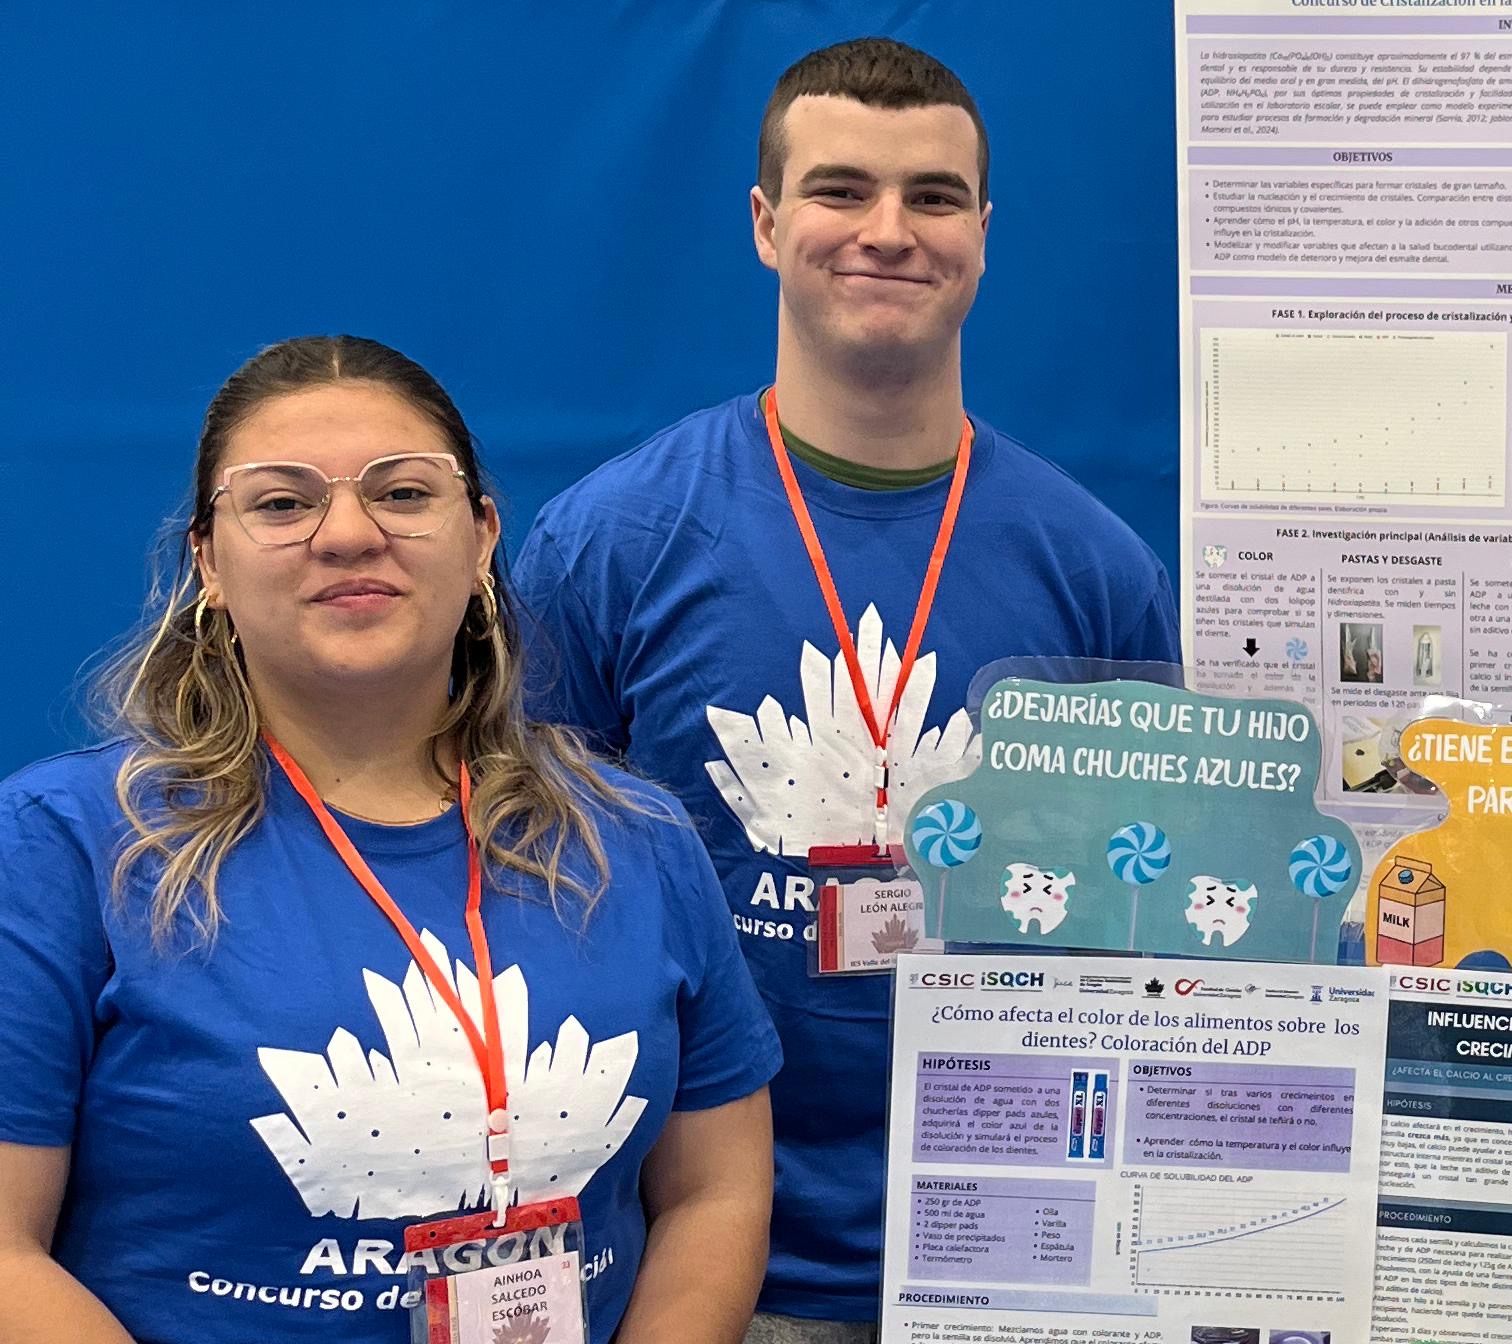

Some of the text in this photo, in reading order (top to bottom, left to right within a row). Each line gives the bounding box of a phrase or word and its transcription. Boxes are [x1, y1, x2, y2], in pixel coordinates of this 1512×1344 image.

[1332, 151, 1393, 163] OBJETIVOS
[1237, 551, 1273, 561] COLOR
[1341, 553, 1442, 566] PASTAS Y DESGASTE
[987, 691, 1313, 741] ¿DEJARÍAS QUE TU HIJO
[1407, 737, 1492, 763] ¿TIENE
[990, 740, 1301, 792] COMA CHUCHES AZULES?
[931, 1003, 1359, 1035] ¿Cómo afecta el color de los alimentos sobre los
[1021, 1030, 1271, 1056] dientes? Coloración del ADP
[922, 1056, 991, 1070] HIPÓTESIS
[1132, 1064, 1192, 1077] OBJETIVOS
[188, 1270, 364, 1311] Concurso
[898, 1292, 989, 1306] PROCEDIMIENTO
